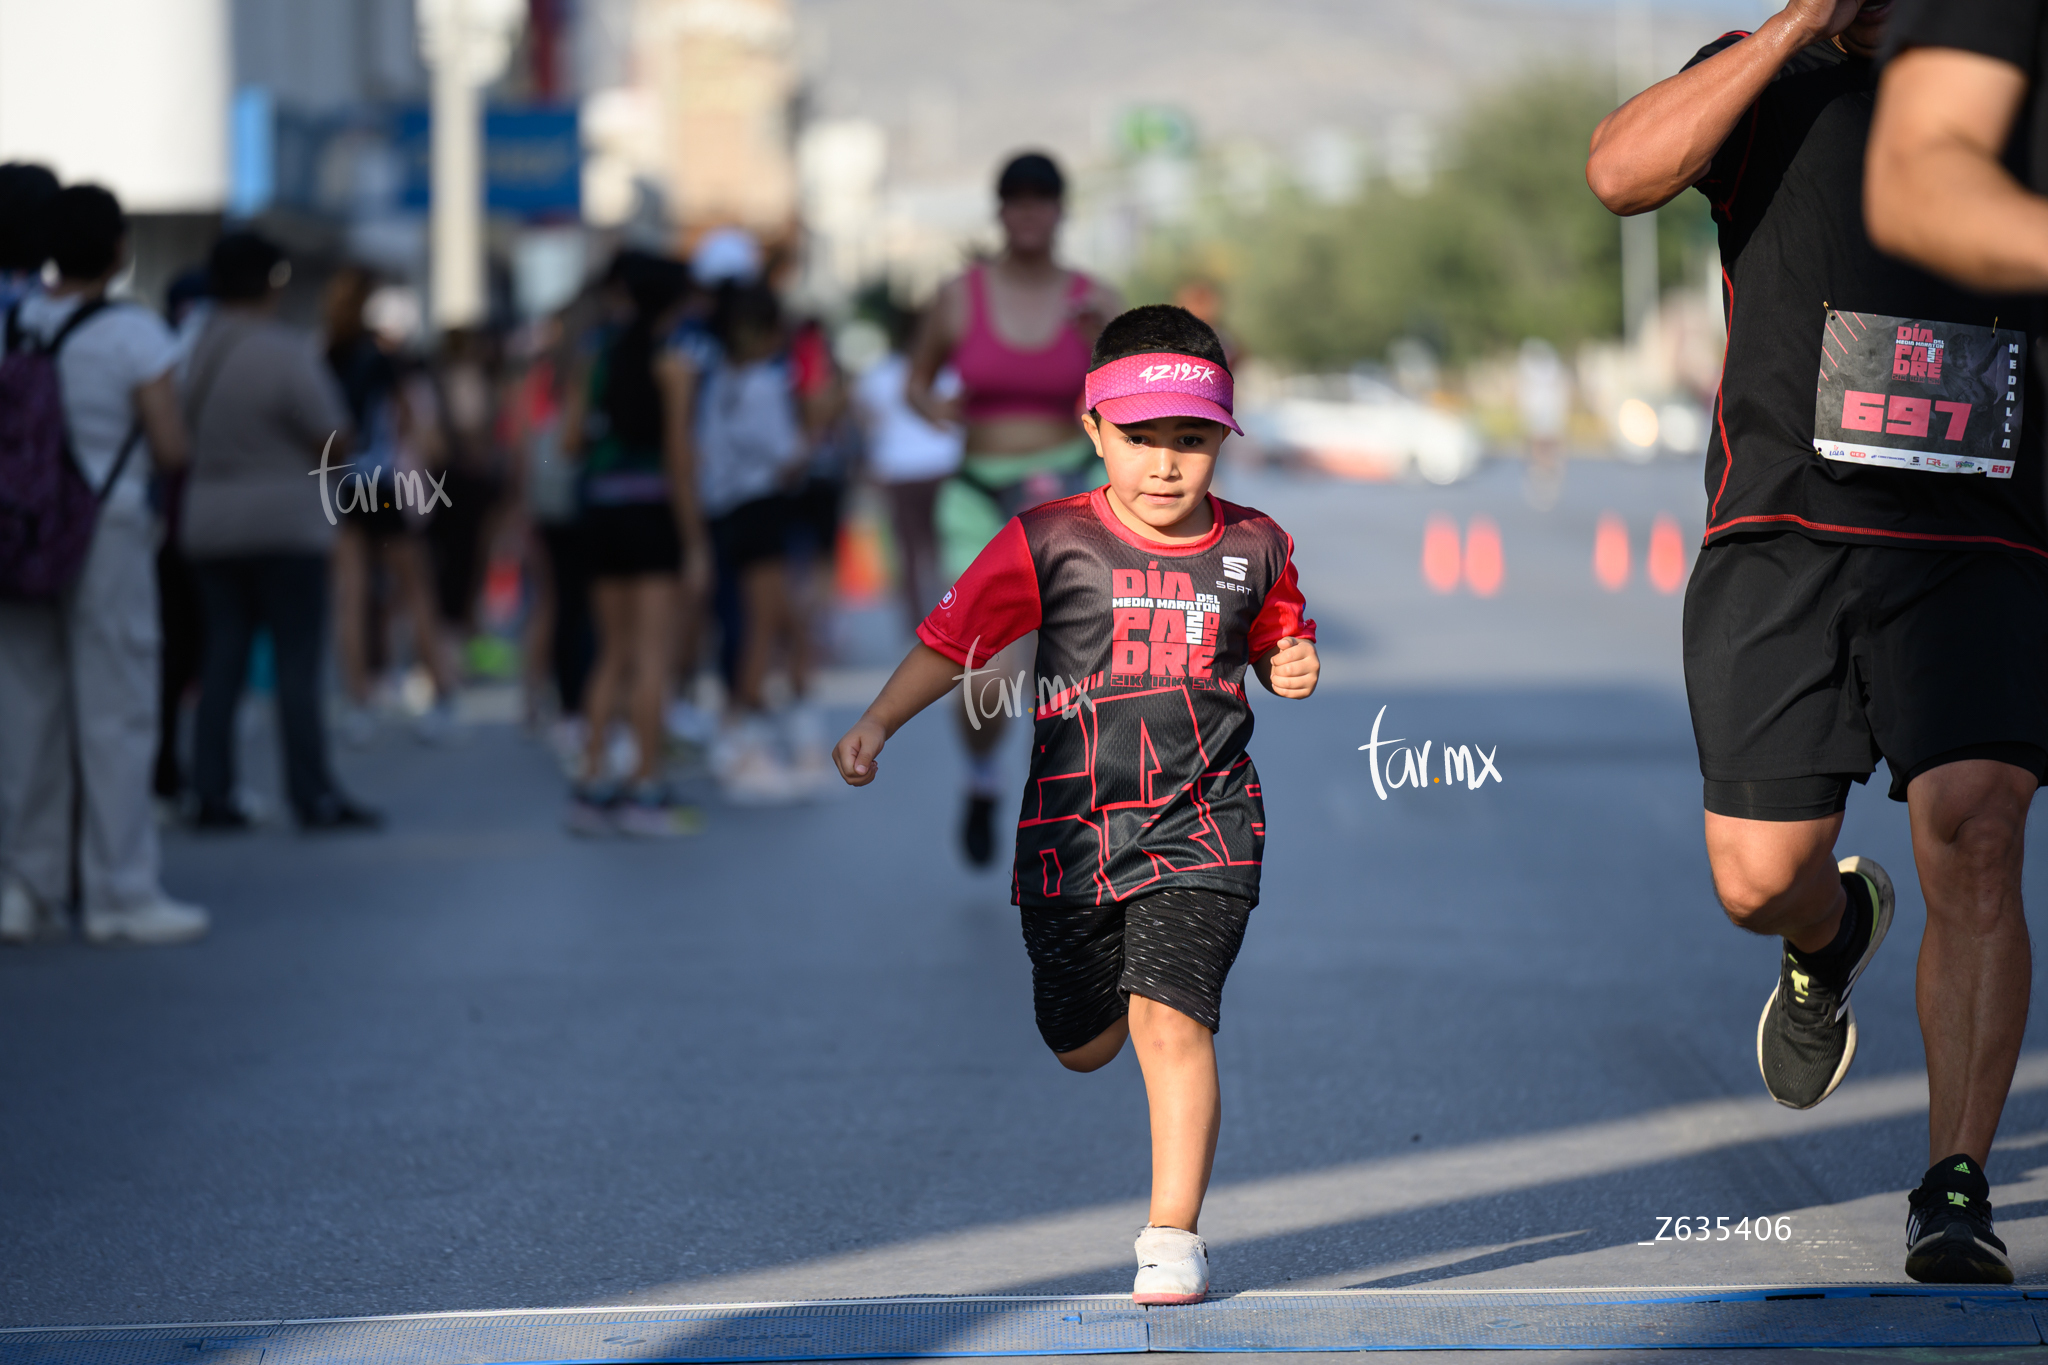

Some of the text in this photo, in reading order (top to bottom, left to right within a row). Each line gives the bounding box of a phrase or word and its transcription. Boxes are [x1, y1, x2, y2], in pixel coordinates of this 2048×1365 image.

[1896, 323, 1934, 343] DÍA
[2002, 343, 2019, 449] MEDALLA
[1841, 390, 1973, 442] 697
[1991, 465, 2011, 474] 697
[1112, 560, 1196, 601] DÍA
[1216, 580, 1252, 595] SEAT
[1112, 598, 1154, 608] MEDIA
[1196, 593, 1220, 604] DEL
[1111, 641, 1216, 678] DRE
[1110, 673, 1216, 690] 21K 10K 5K
